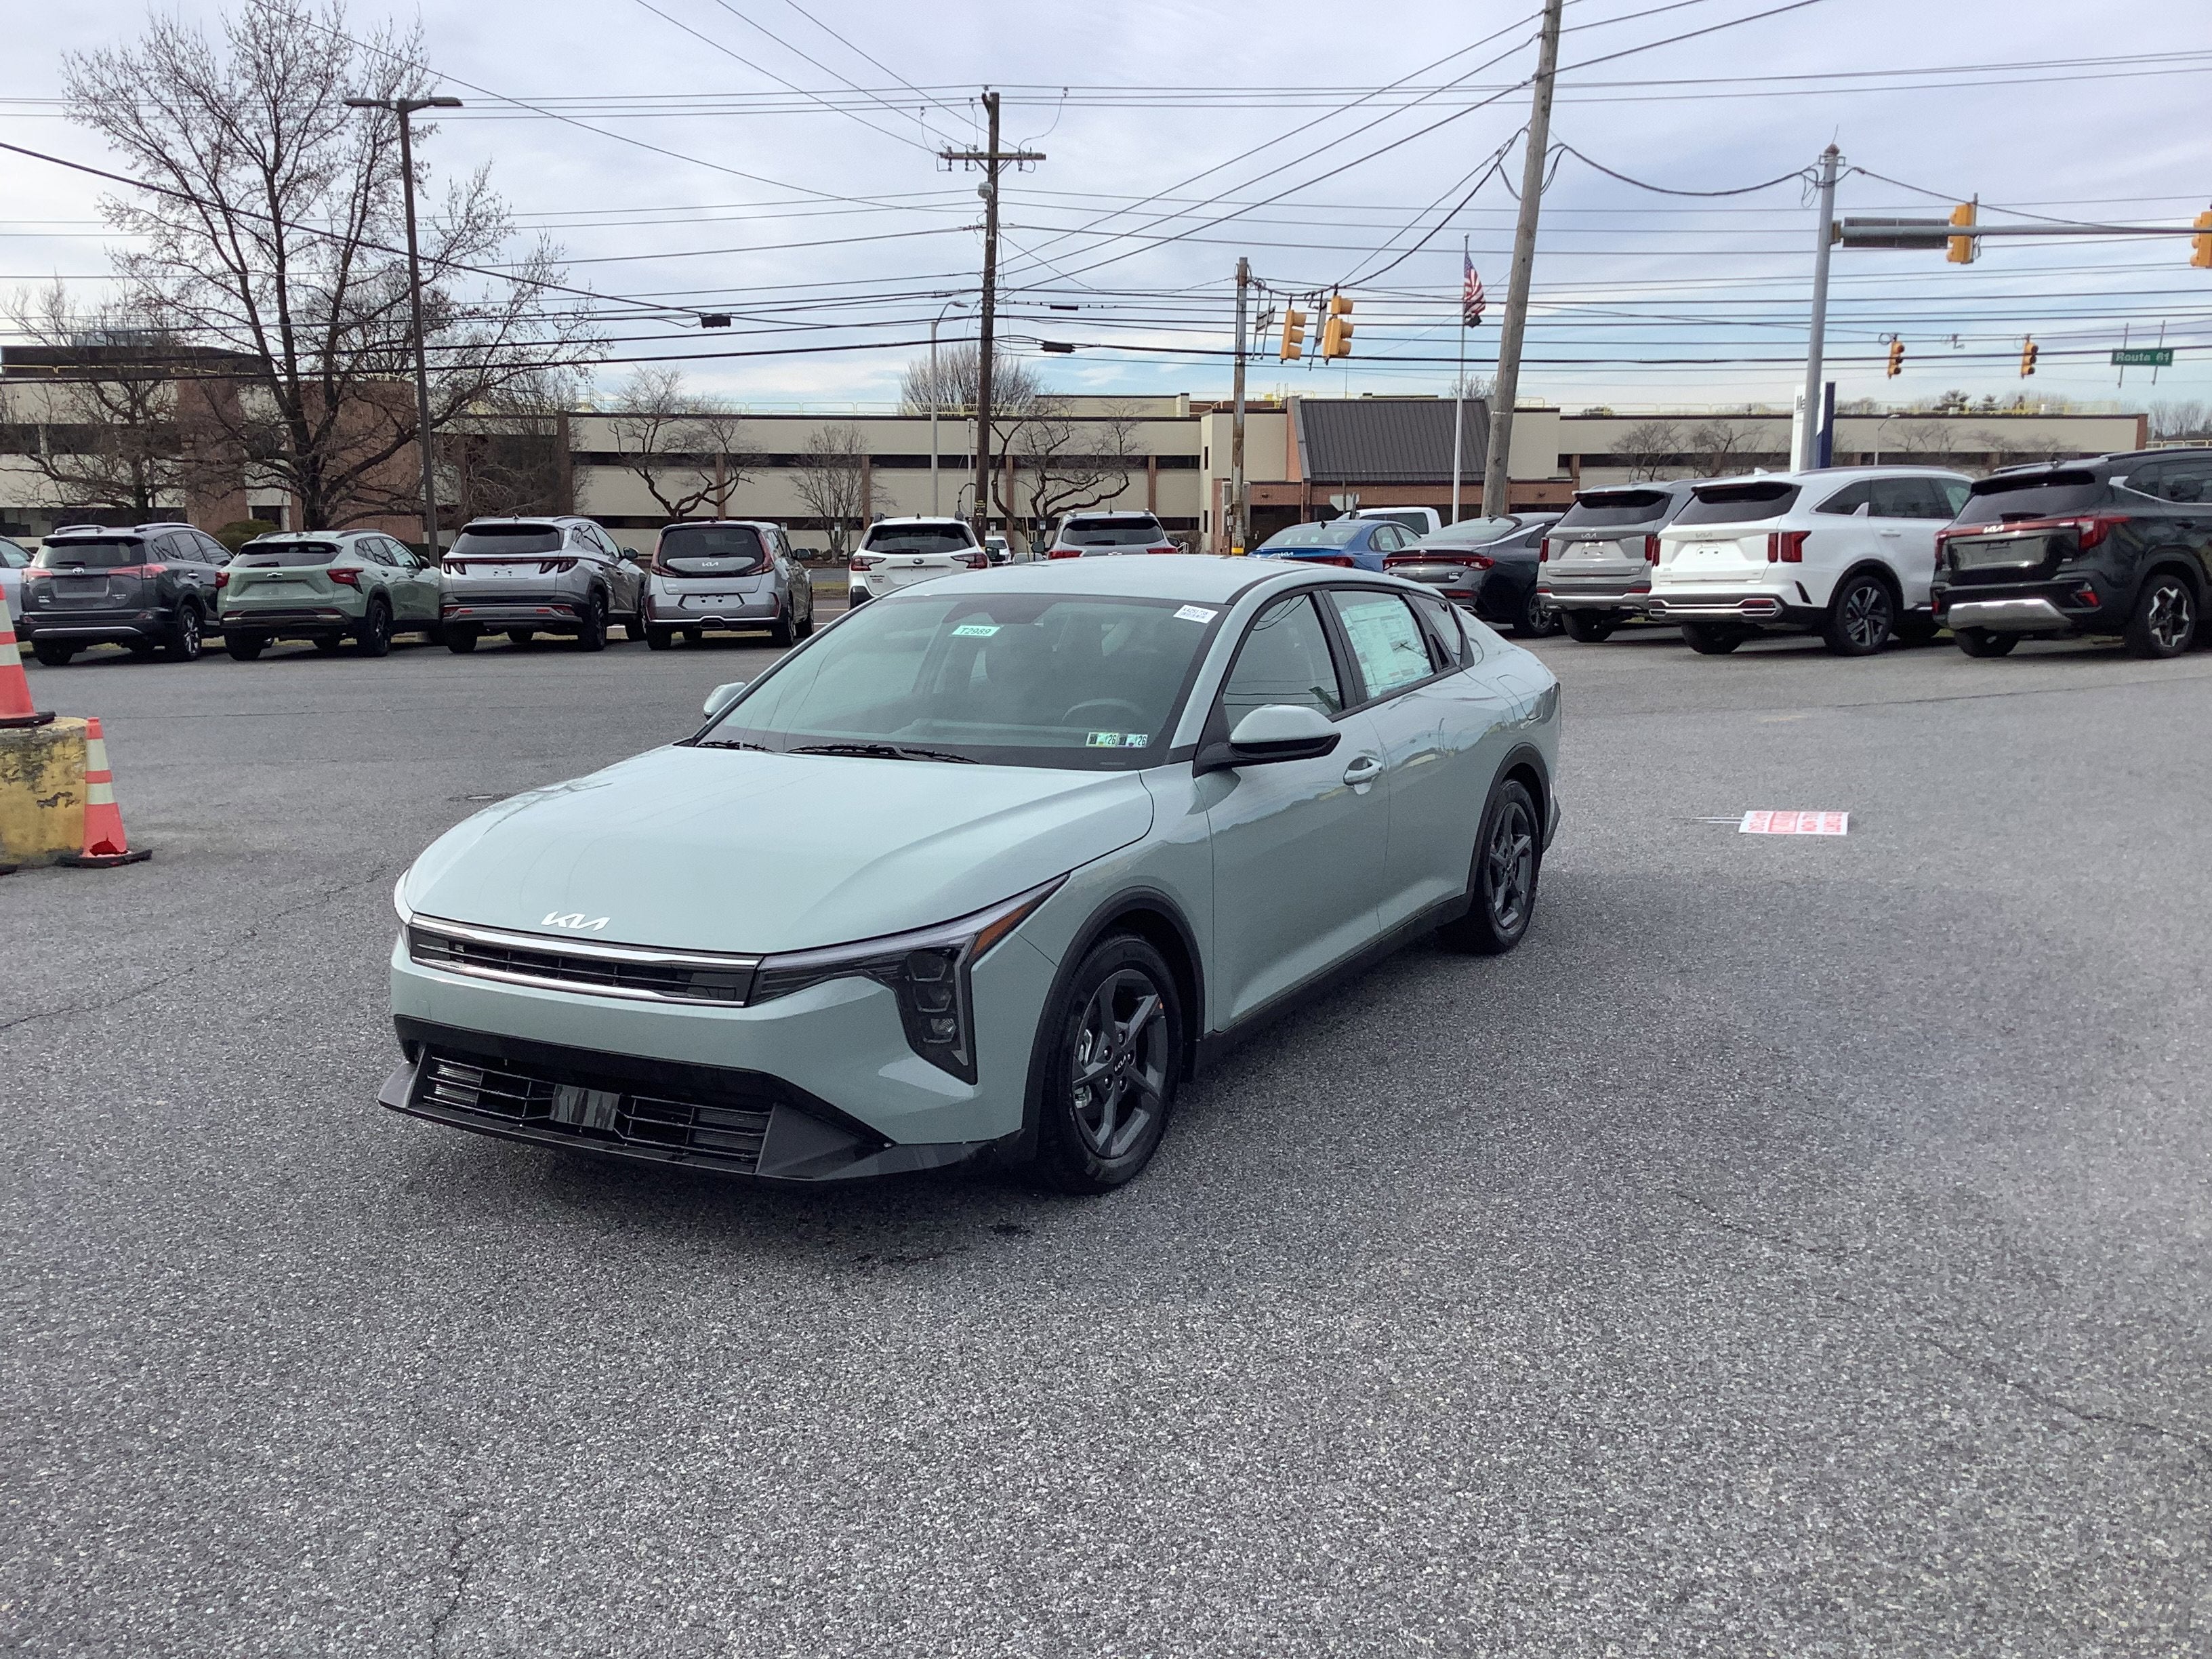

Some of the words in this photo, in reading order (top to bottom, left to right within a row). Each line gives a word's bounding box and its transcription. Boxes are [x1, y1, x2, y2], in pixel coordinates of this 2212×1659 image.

[2116, 352, 2151, 362] Route
[1983, 525, 2005, 533] KIA
[541, 911, 611, 932] KIA
